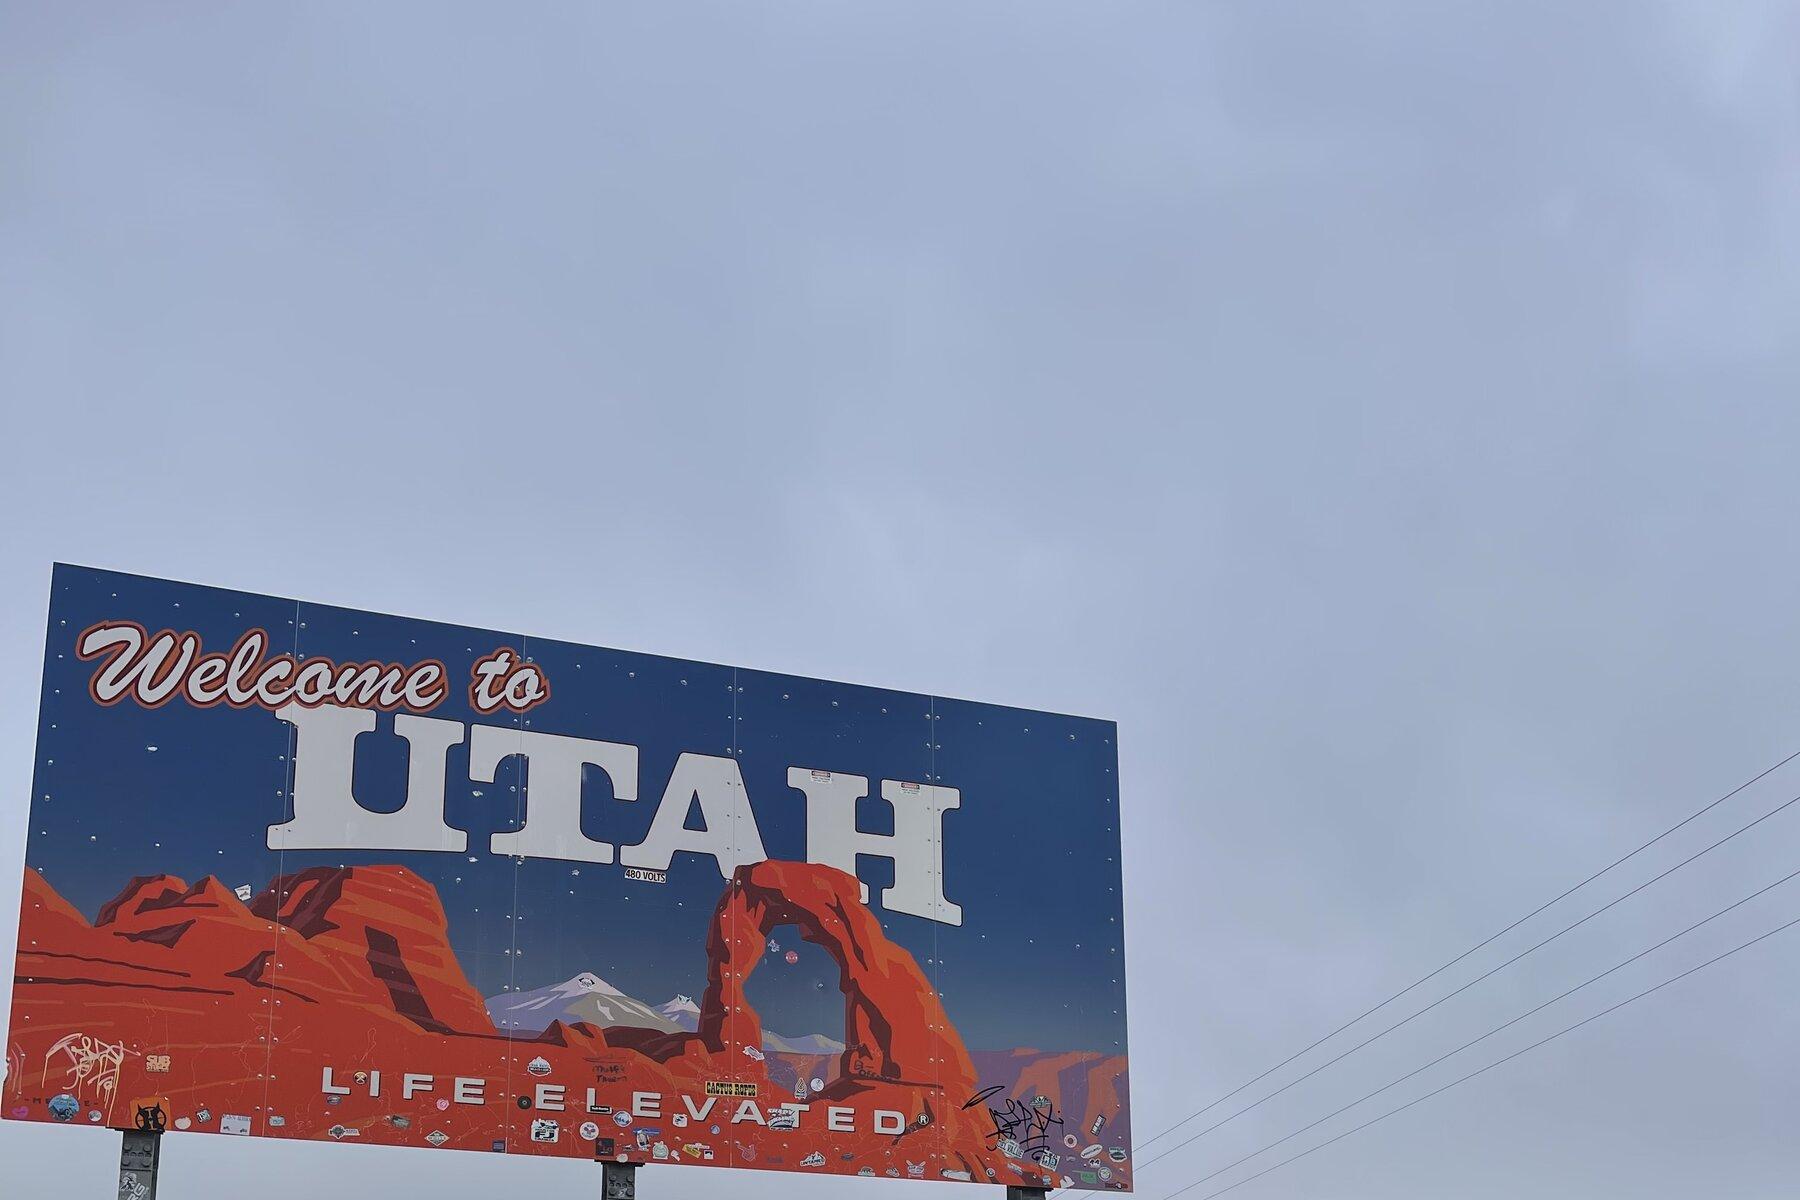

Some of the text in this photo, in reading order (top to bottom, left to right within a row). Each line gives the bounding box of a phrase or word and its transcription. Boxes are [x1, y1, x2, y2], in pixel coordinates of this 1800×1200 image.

[77, 621, 550, 713] Welcome to
[267, 703, 963, 927] UTAH
[625, 869, 666, 882] 480 VOLTS
[322, 1066, 485, 1106] LIFE
[535, 1083, 907, 1136] ELEVATED
[706, 1082, 733, 1095] CACTUS
